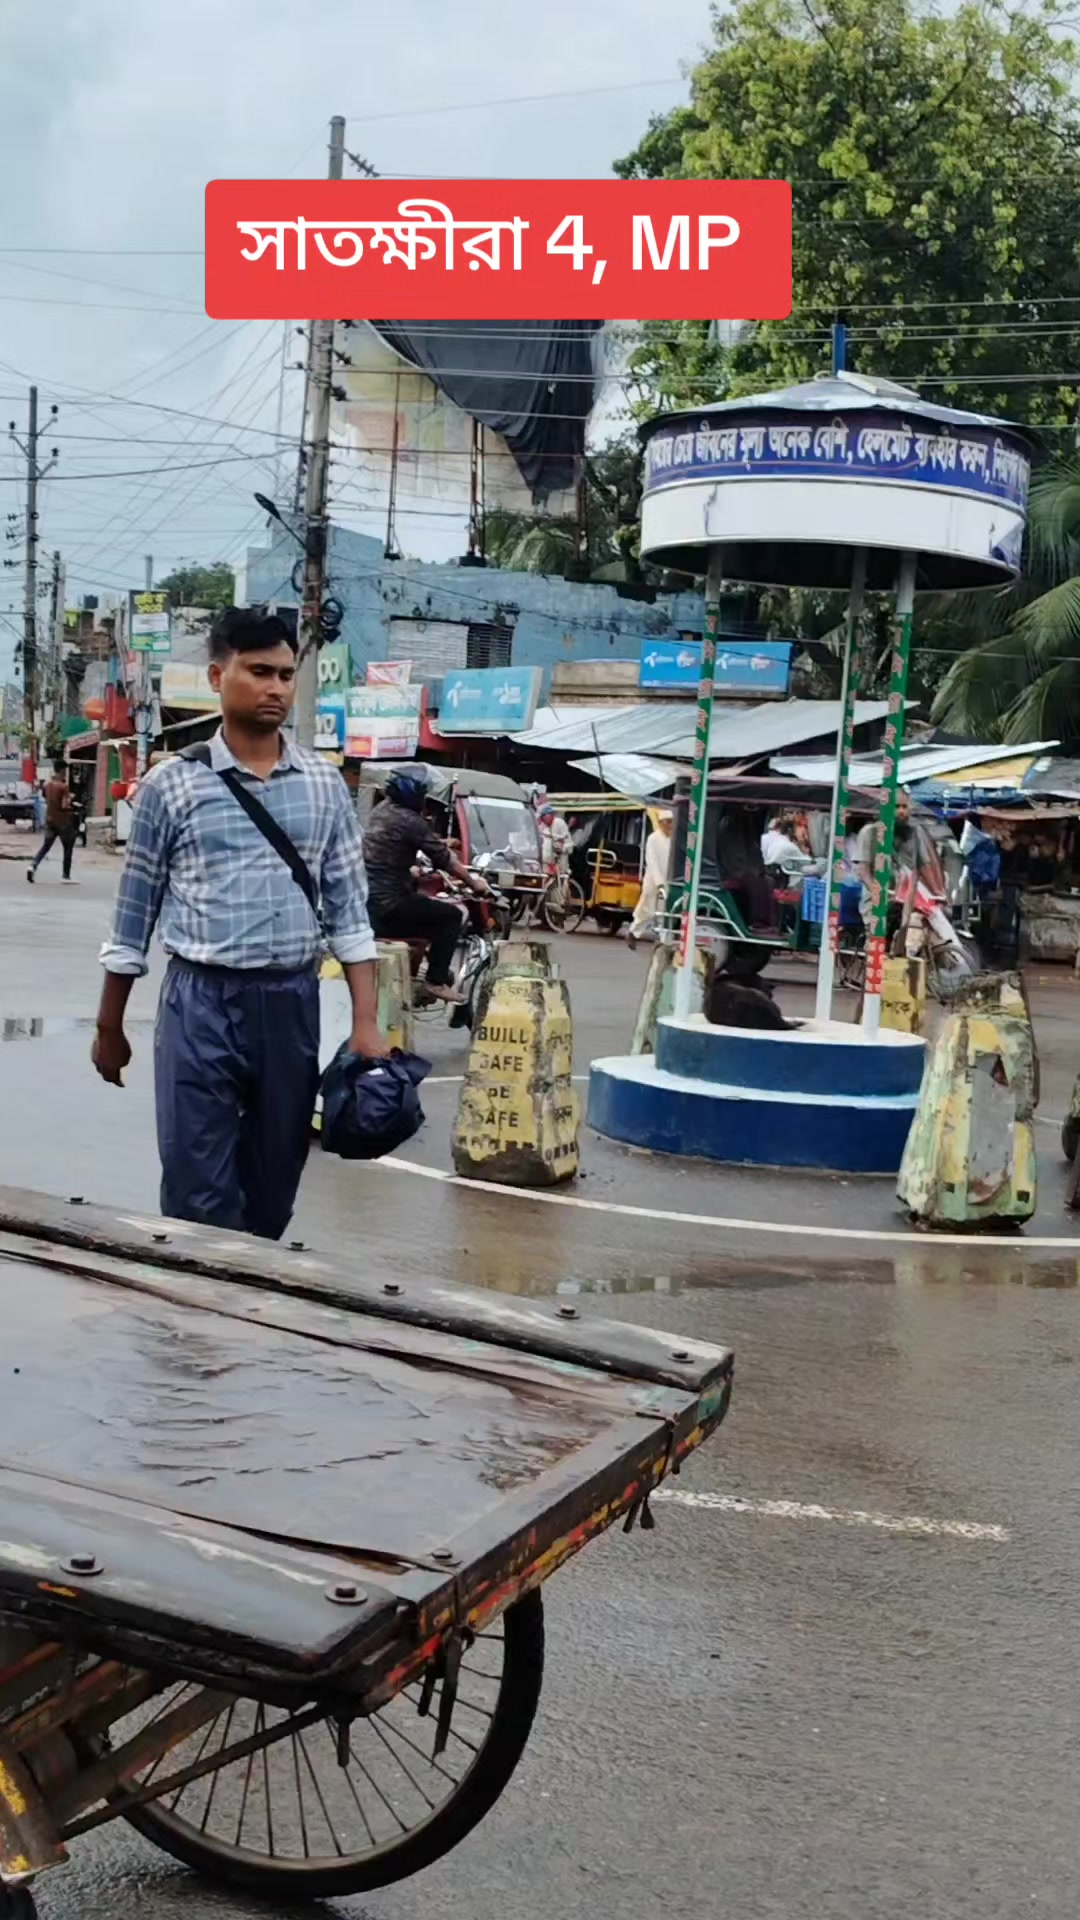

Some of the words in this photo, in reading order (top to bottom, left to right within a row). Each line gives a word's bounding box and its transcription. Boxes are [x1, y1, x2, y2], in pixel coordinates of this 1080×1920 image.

[695, 419, 739, 463] জীবনের
[768, 426, 813, 459] অনেক
[814, 416, 853, 467] বেশি,
[857, 421, 913, 464] হেলমেট
[475, 1111, 520, 1128] AFE
